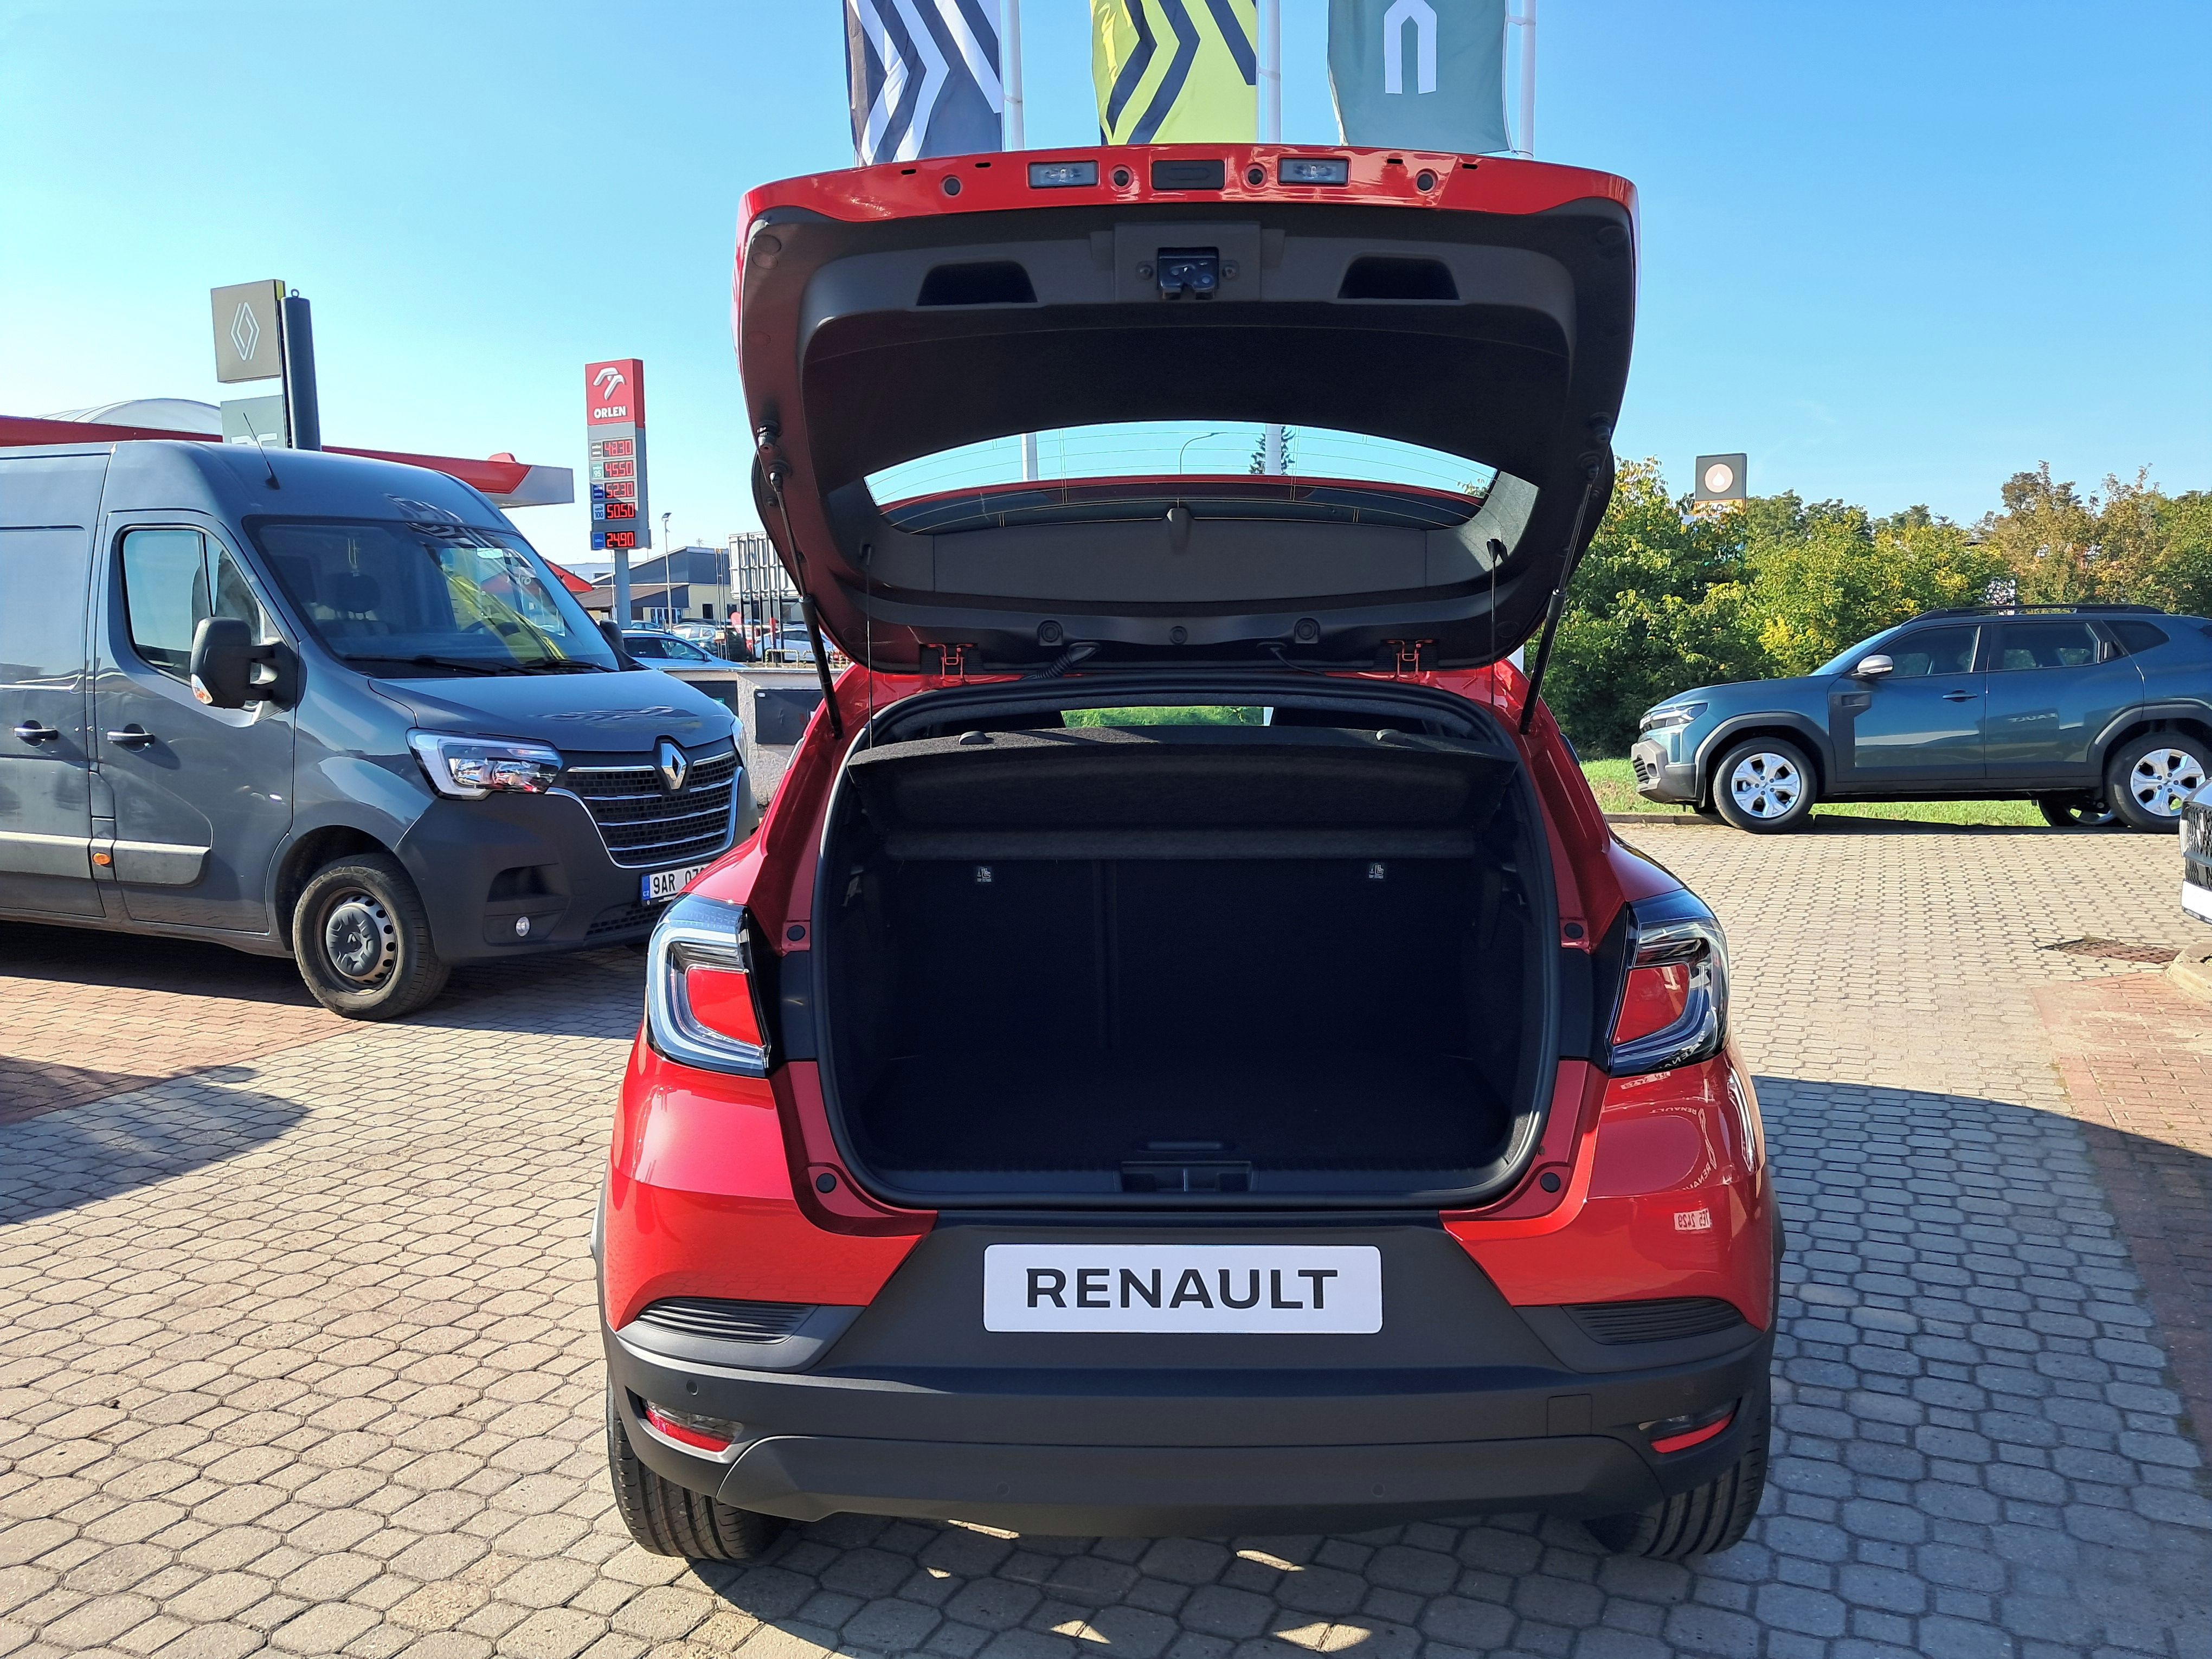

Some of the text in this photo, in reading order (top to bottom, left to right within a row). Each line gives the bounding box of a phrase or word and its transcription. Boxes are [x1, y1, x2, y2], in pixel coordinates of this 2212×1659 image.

[593, 406, 627, 419] ORLEN
[605, 461, 633, 477] 4550
[606, 483, 634, 498] 5230
[607, 503, 634, 518] 5050
[607, 532, 634, 547] 2490
[653, 873, 676, 895] 9AR
[1026, 1268, 1338, 1310] RENAULT
